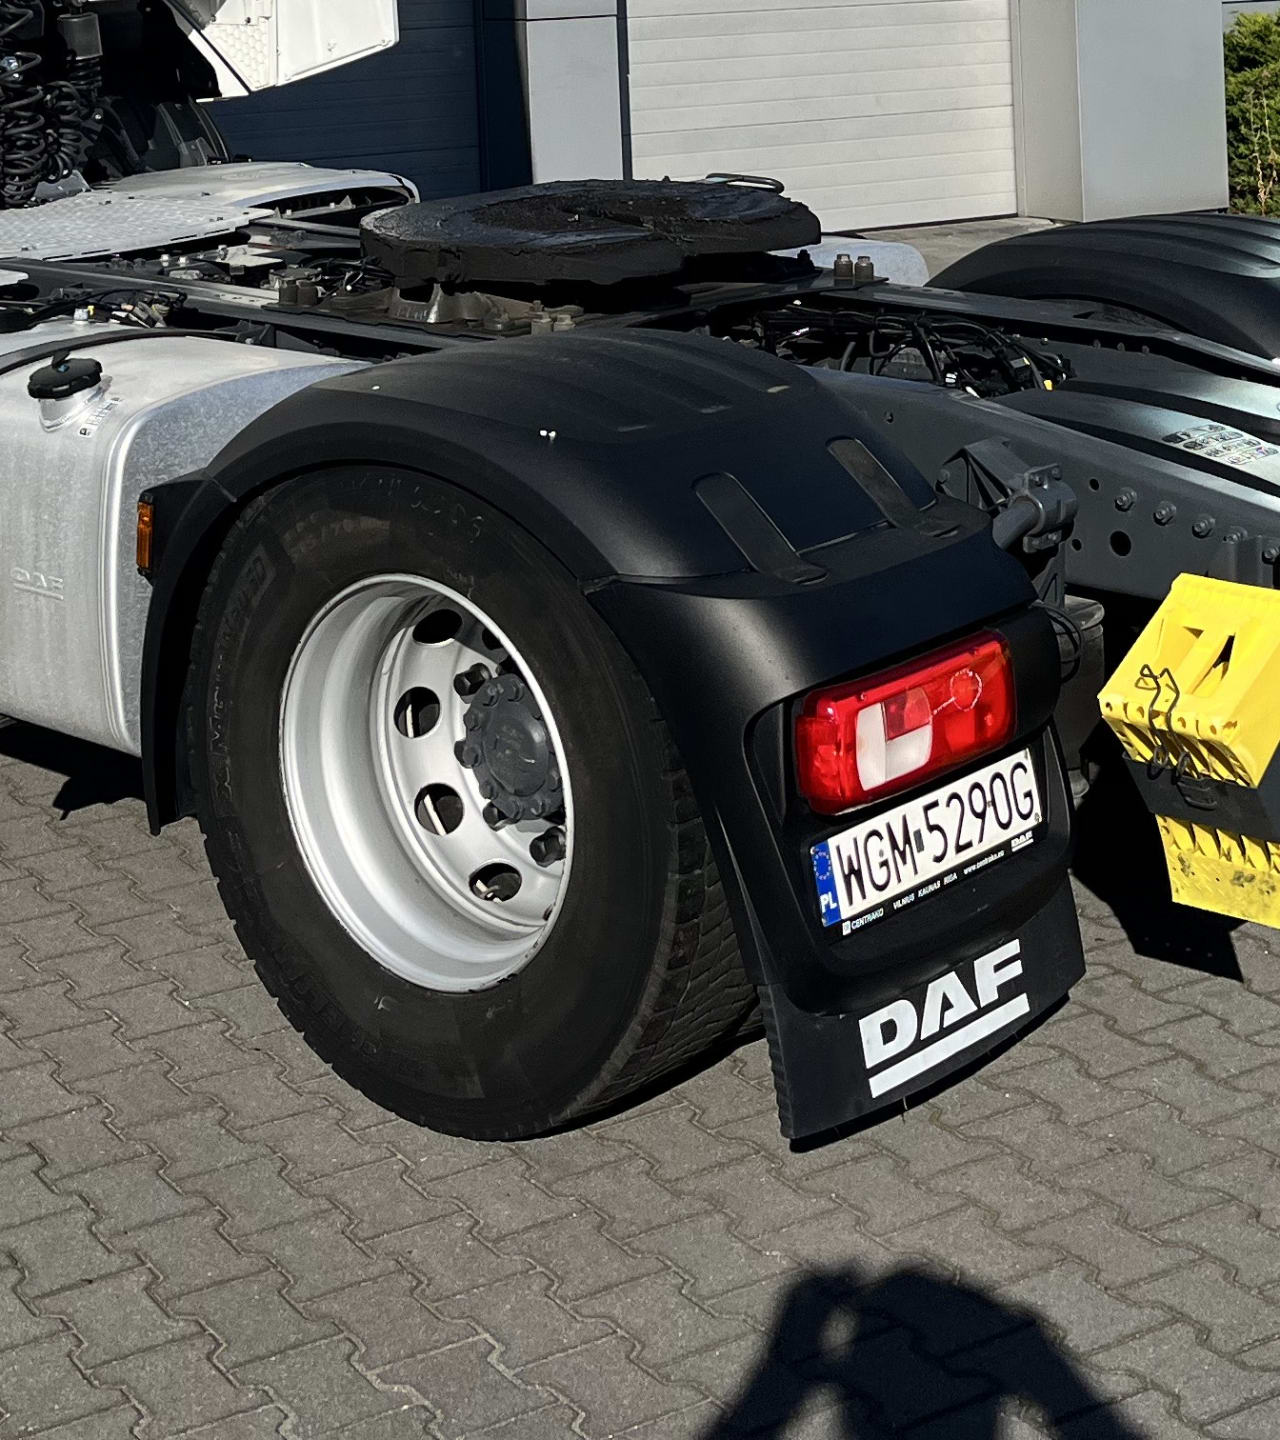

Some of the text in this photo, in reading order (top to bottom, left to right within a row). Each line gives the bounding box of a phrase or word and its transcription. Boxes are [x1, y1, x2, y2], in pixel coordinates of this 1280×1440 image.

[821, 891, 837, 914] PL
[851, 908, 884, 930] CENTRAKO
[859, 939, 1023, 1069] DAF
